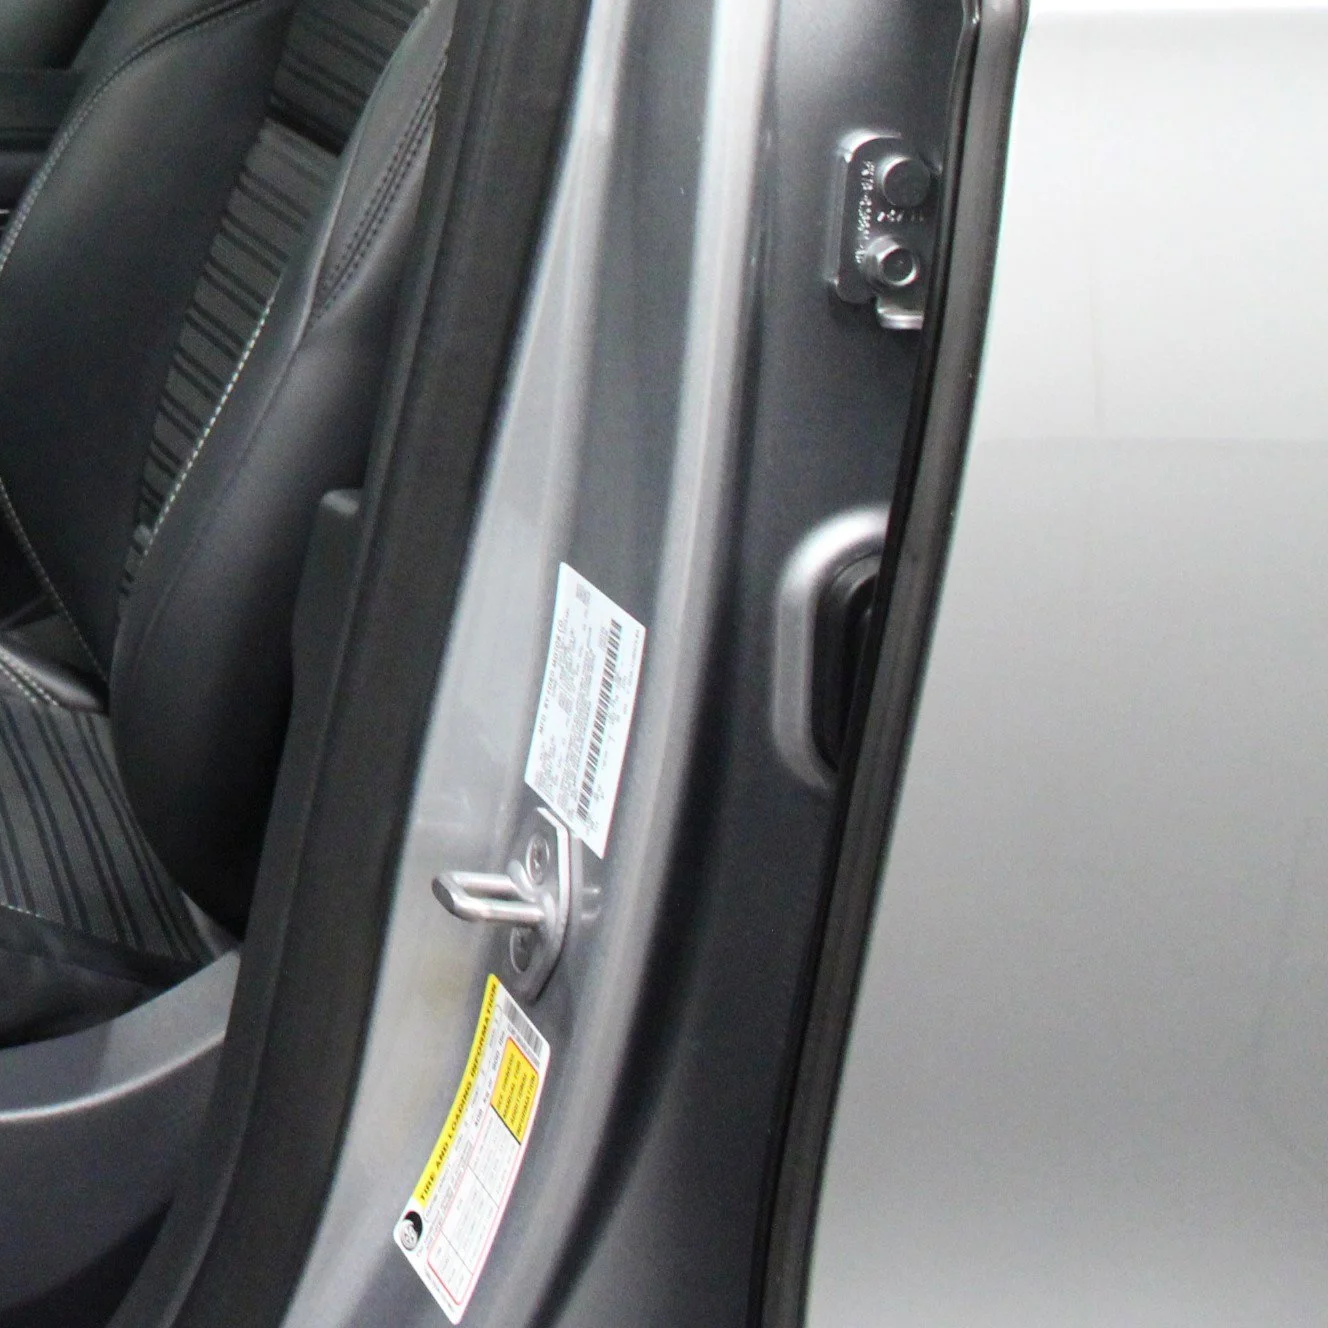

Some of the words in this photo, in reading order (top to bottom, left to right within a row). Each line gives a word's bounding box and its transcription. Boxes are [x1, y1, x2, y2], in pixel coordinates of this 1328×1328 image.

[419, 1169, 436, 1203] TIRE
[434, 1139, 449, 1170] AND
[447, 1079, 472, 1140] LOADING
[469, 981, 497, 1078] INFORMATION
